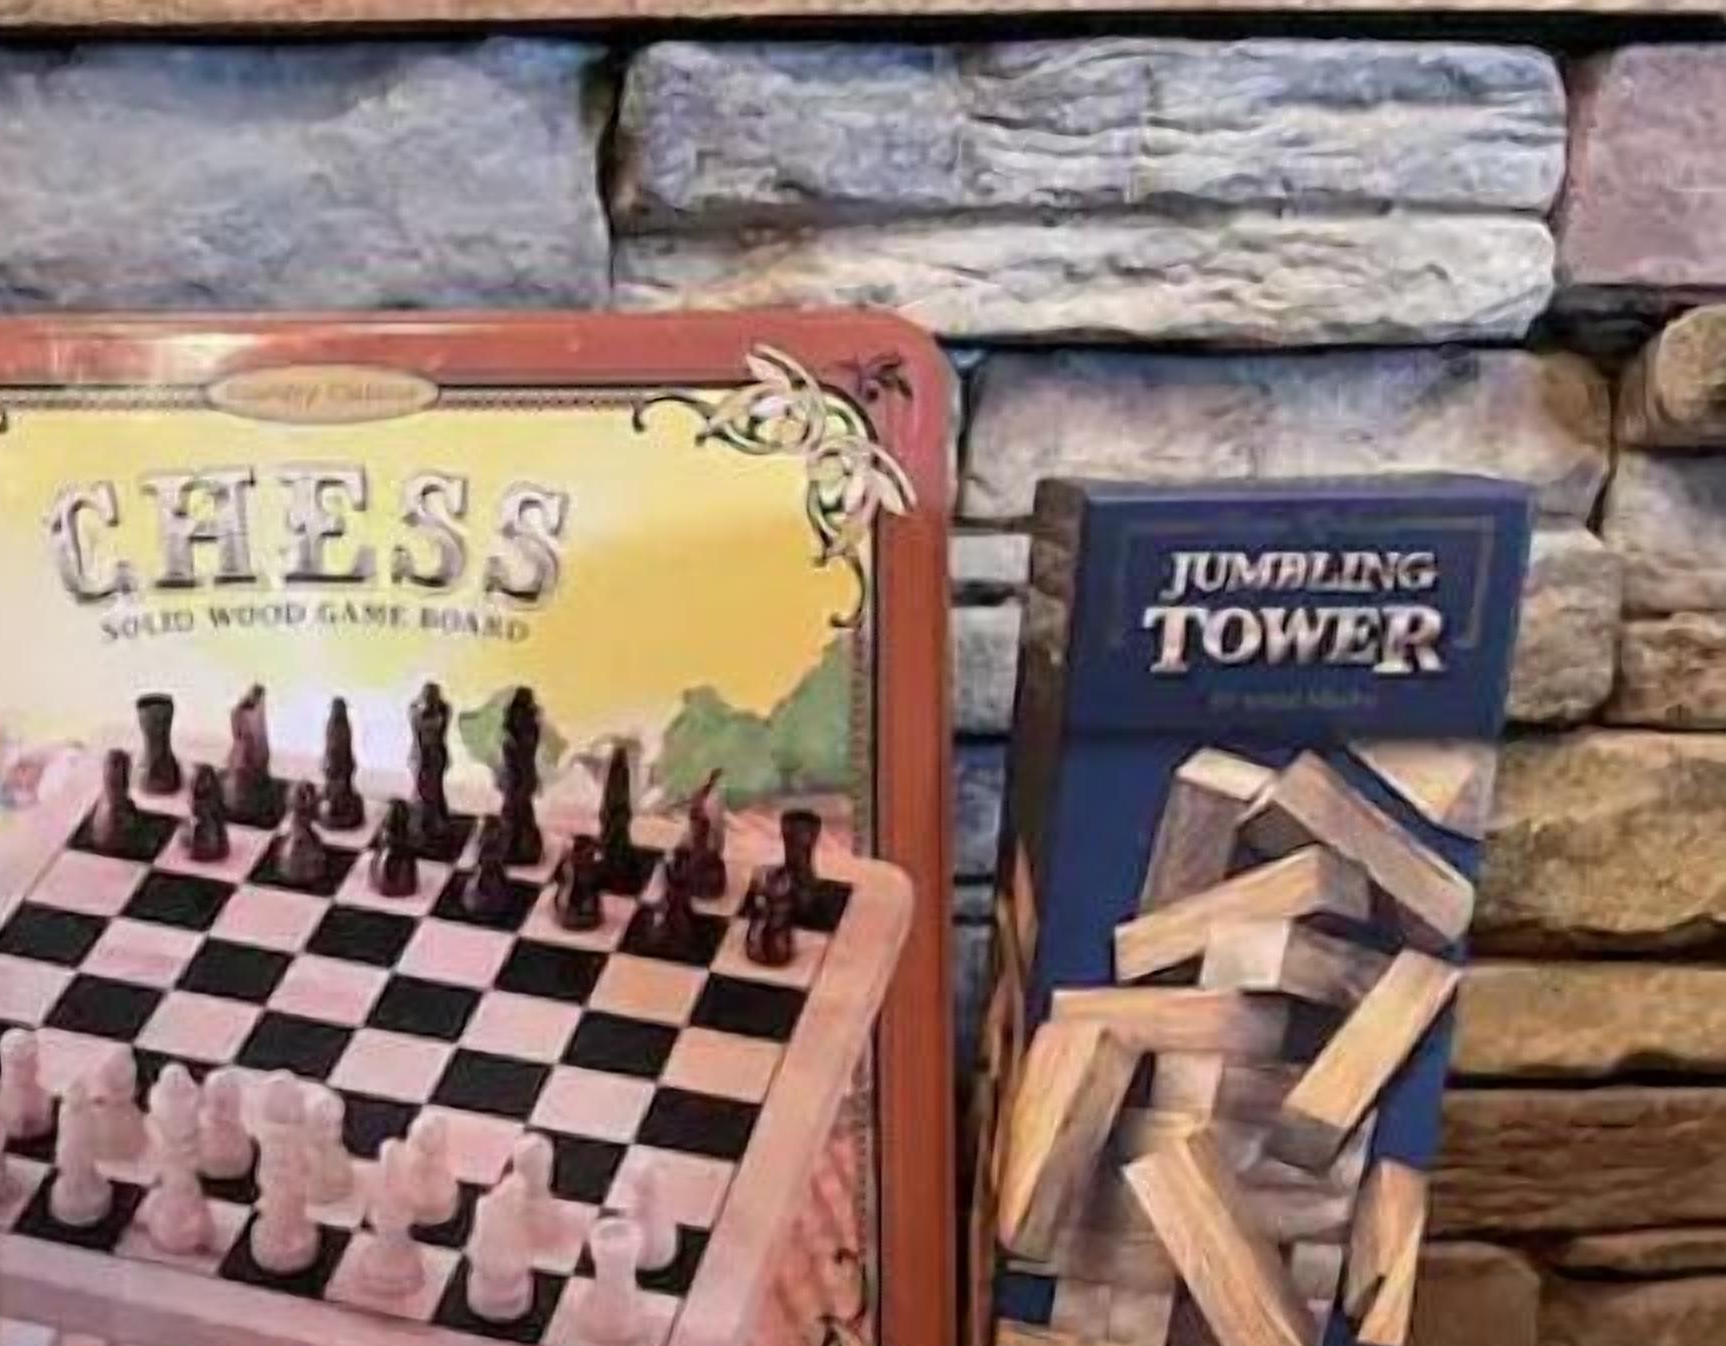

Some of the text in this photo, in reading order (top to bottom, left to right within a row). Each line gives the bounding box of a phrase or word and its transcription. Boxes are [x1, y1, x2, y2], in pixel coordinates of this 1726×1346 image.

[52, 463, 570, 604] CHESS
[1162, 551, 1439, 600] JUMBLING
[101, 609, 195, 641] SOLID
[208, 604, 307, 628] WOOD
[317, 602, 405, 627] GAME
[1142, 605, 1444, 674] TOWER
